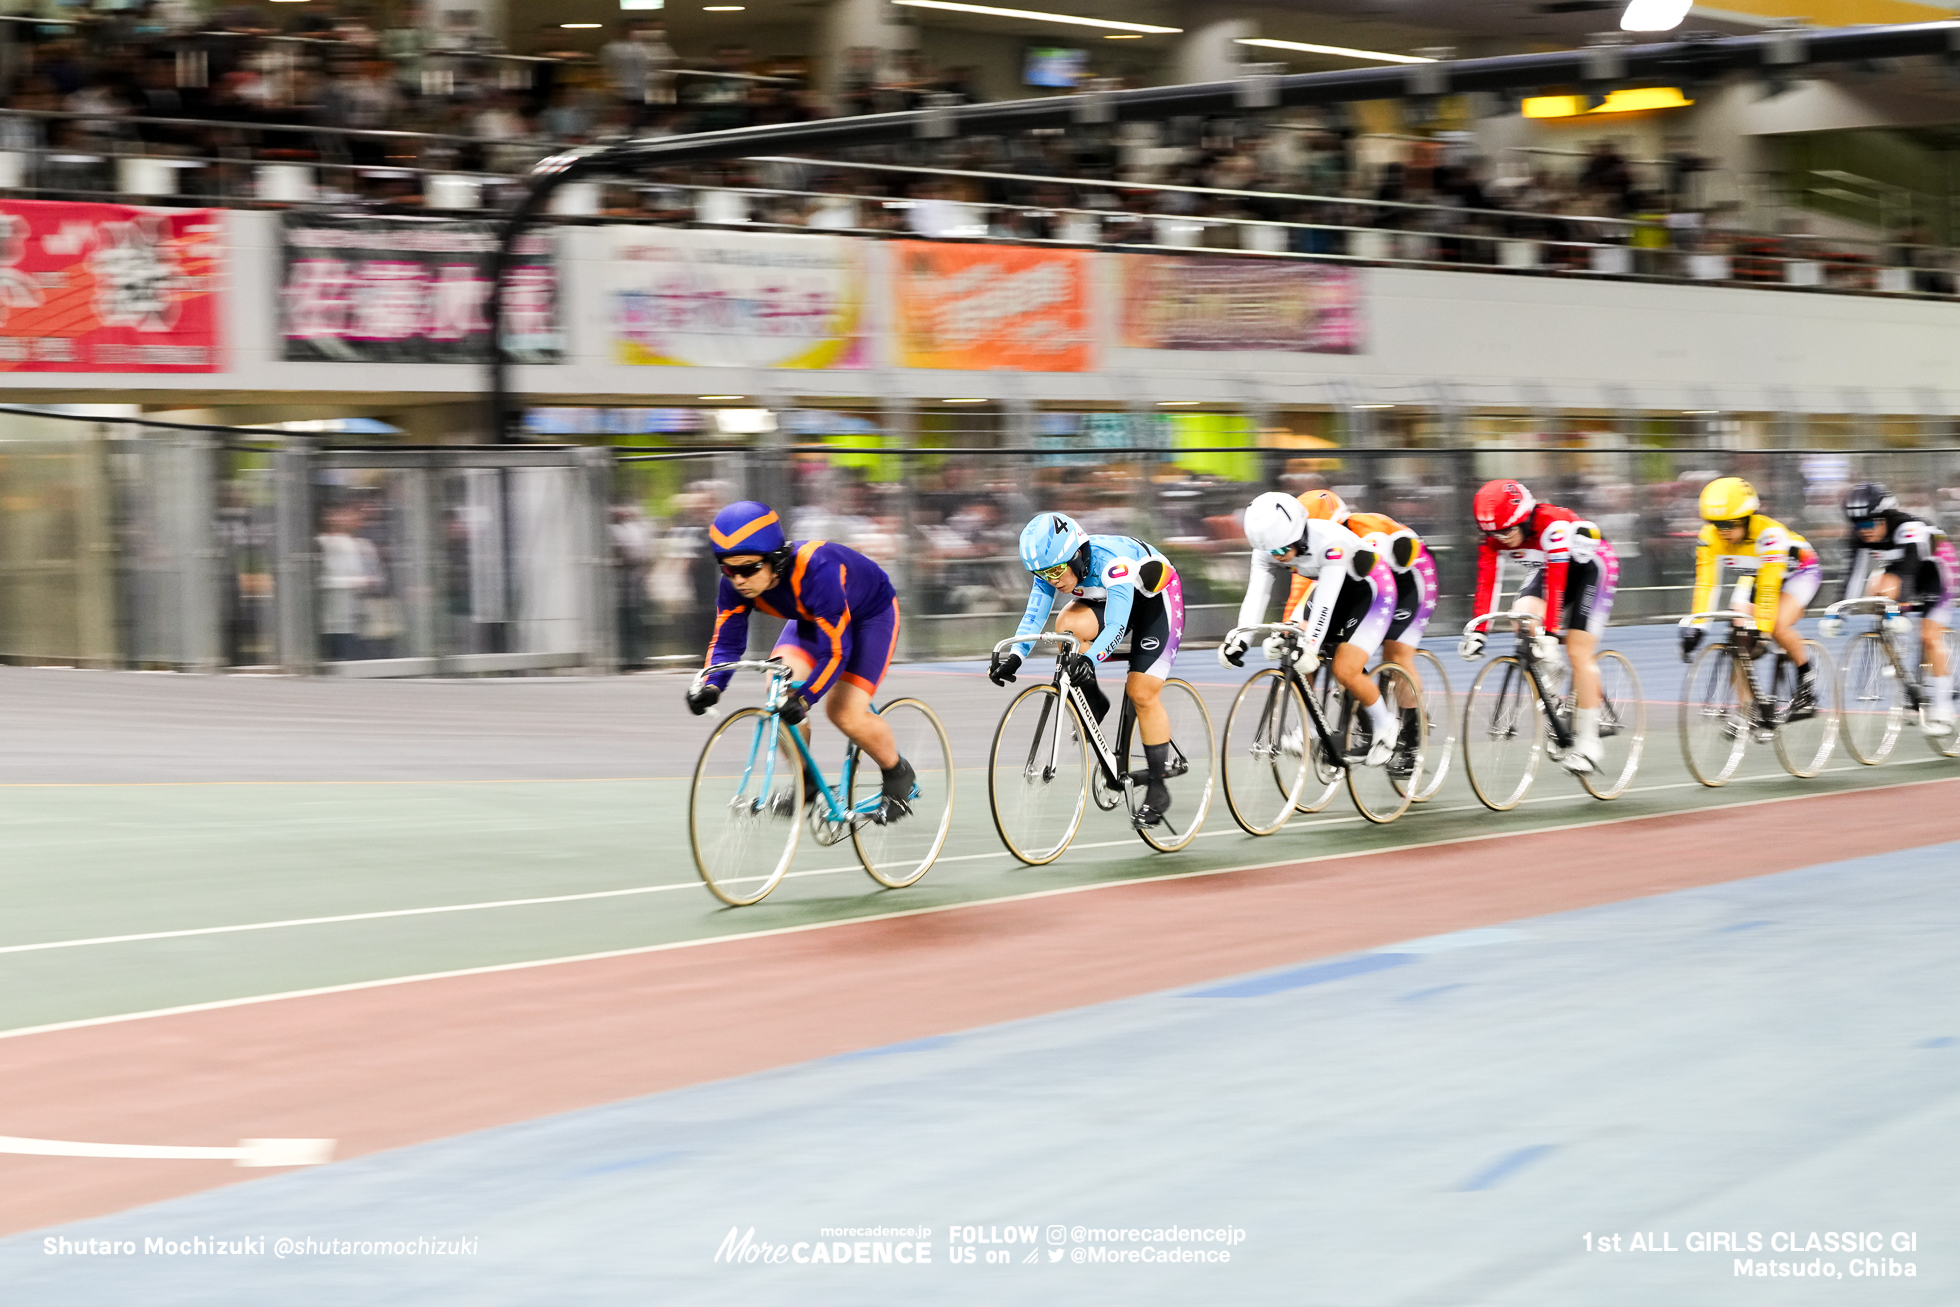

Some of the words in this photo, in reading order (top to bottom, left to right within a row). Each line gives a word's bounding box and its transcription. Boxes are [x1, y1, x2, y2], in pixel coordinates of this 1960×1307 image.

[1275, 503, 1292, 522] 1
[1053, 515, 1069, 535] 4
[1105, 624, 1126, 655] KEIRIN
